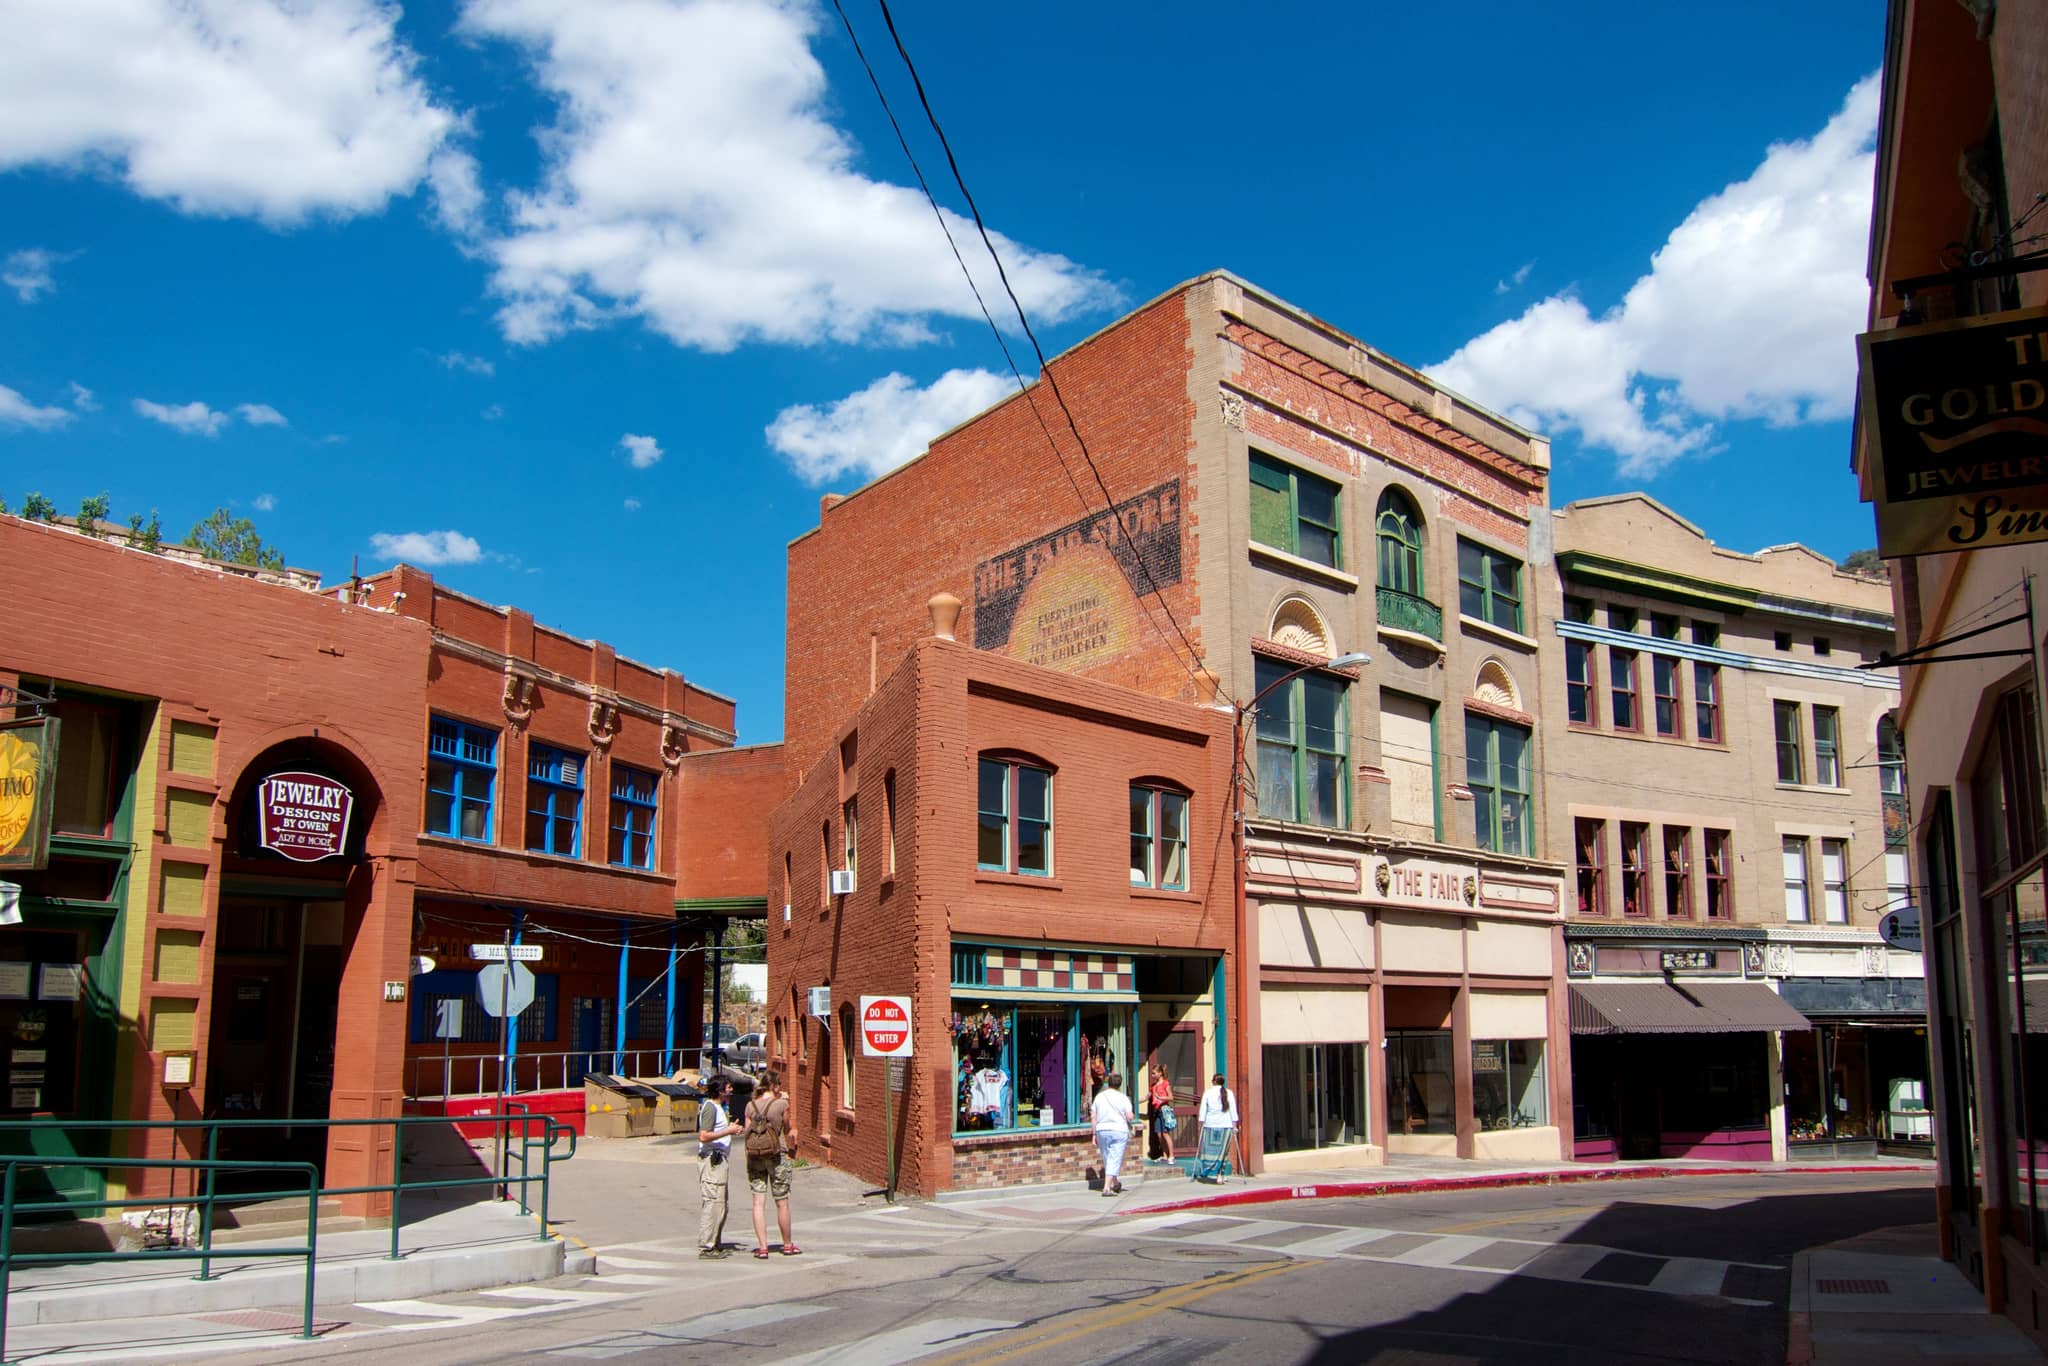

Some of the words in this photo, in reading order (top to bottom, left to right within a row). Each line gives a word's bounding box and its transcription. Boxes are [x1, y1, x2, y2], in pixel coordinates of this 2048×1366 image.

[1901, 378, 2046, 427] GOLD
[1905, 455, 2048, 495] JEWELR
[978, 554, 1018, 599] THE
[1089, 489, 1179, 548] STORE
[1038, 594, 1102, 628] EVERYTHING
[1052, 633, 1107, 661] CHILDREN
[269, 779, 344, 809] JEWELRY
[272, 805, 341, 823] DESIGNS
[283, 818, 297, 829] BY
[298, 819, 330, 832] OWEN
[278, 833, 296, 843] ART
[297, 836, 305, 844] &
[308, 836, 333, 847] MORE
[1392, 867, 1423, 897] THE
[1430, 872, 1460, 902] FAIR
[489, 947, 508, 957] MAI
[869, 1007, 880, 1018] DO
[884, 1007, 899, 1018] NOT
[873, 1033, 899, 1044] ENTER
